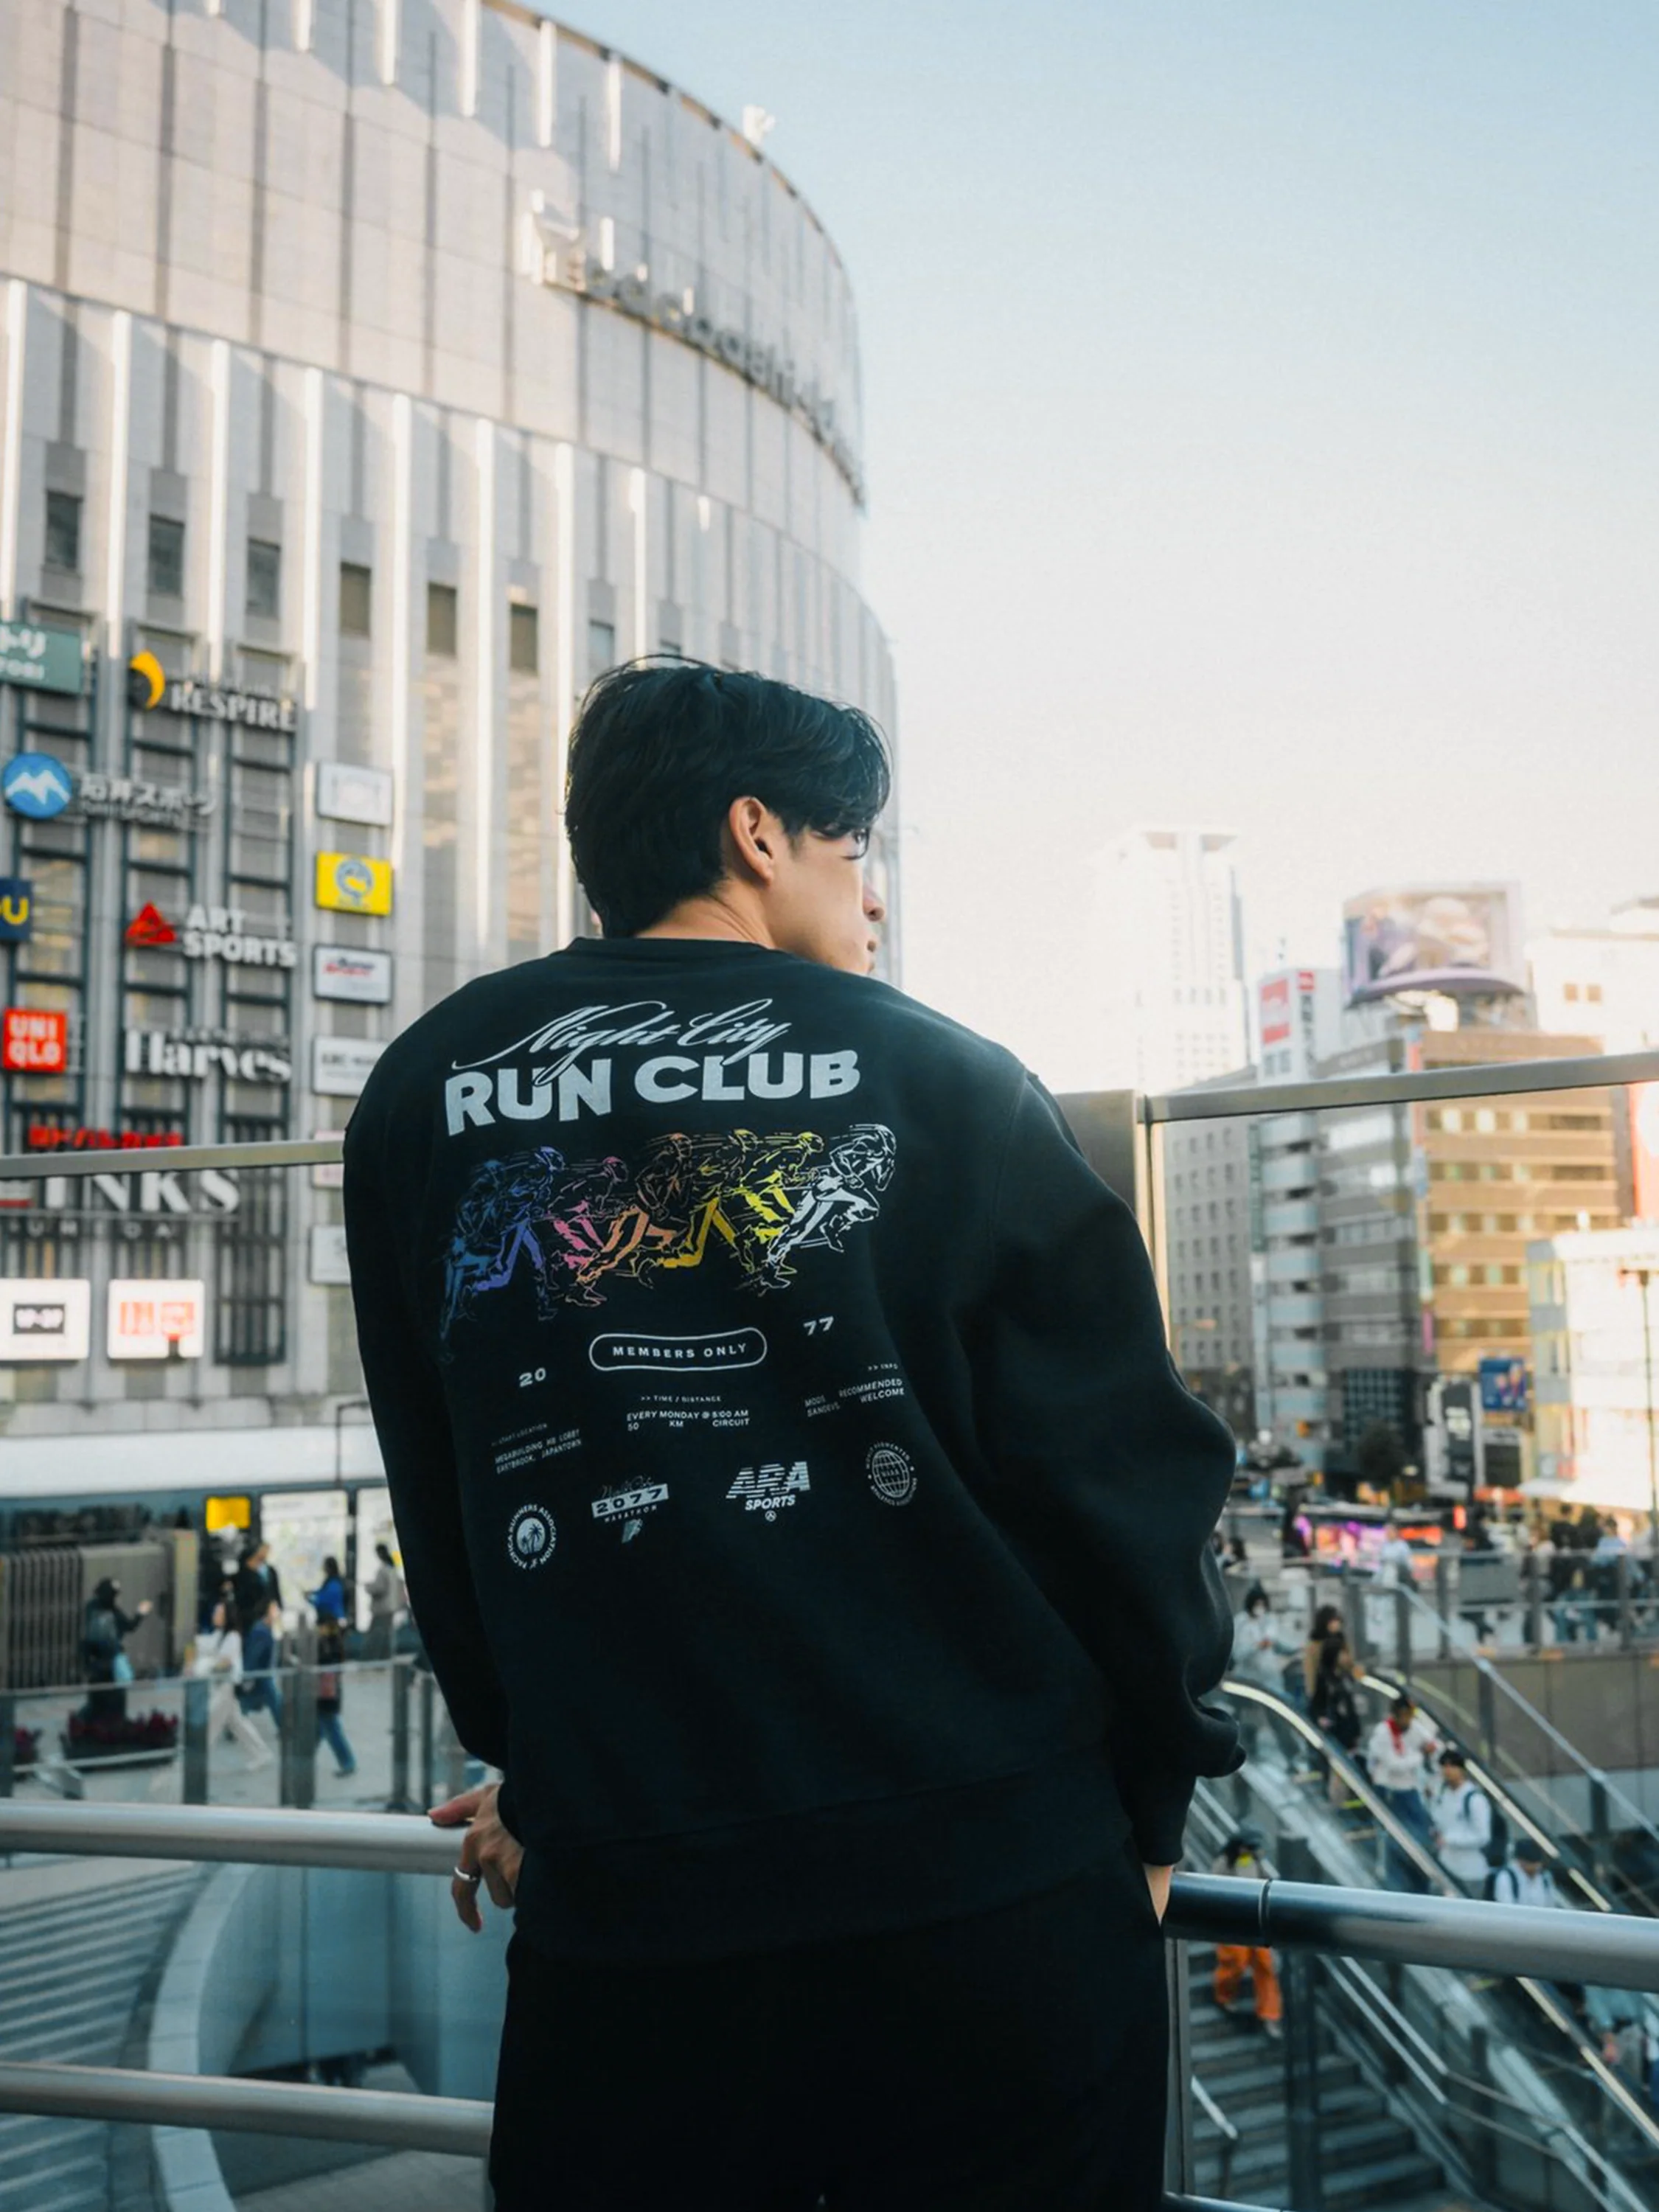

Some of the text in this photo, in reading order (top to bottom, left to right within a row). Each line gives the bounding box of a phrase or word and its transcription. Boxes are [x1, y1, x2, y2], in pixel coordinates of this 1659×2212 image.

[170, 681, 295, 729] RESPIRE
[186, 904, 246, 934] ART
[183, 931, 296, 967] SPORTS
[10, 1015, 58, 1040] UNI
[451, 998, 792, 1085] Night City
[10, 1041, 61, 1067] QLO
[126, 1032, 291, 1081] Harves
[445, 1049, 860, 1136] RUN CLUB
[804, 1316, 835, 1335] 77
[613, 1343, 747, 1358] MEMBERS ONLY
[519, 1368, 546, 1388] 20
[838, 1378, 902, 1397] RECOMMENDED
[860, 1387, 905, 1403] WELCOME
[627, 1411, 658, 1422] EVERY
[659, 1410, 700, 1419] MONDAY
[734, 1409, 749, 1418] AM
[627, 1418, 750, 1431] 50 KM CIRCUIT
[541, 1439, 582, 1458] JAPANTOWN
[596, 1487, 663, 1514] 2077
[745, 1494, 796, 1511] SPORTS
[605, 1504, 657, 1523] MARATHON
[538, 1506, 557, 1564] ASSOCIATION
